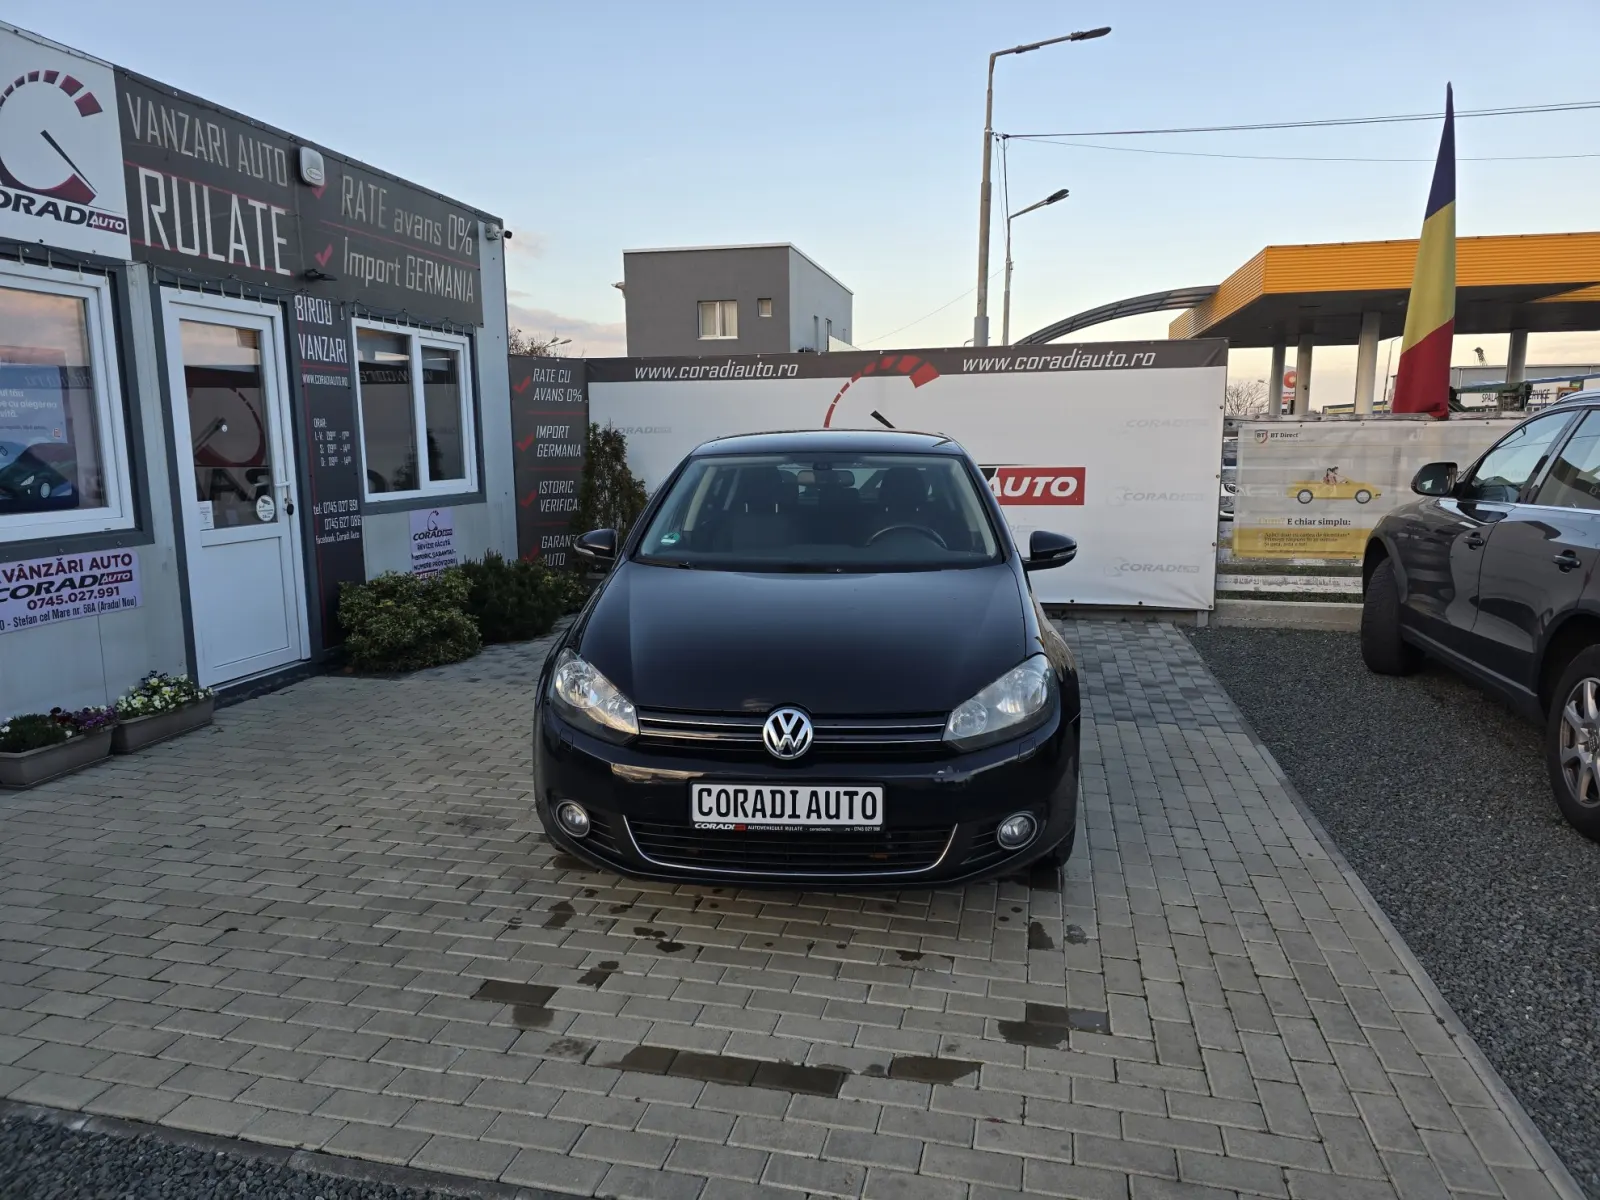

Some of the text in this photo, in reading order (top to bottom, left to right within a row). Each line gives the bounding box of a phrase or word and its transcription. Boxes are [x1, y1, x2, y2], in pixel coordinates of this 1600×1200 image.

[126, 92, 288, 188] VANZARI AUTO
[89, 211, 125, 231] AUTO
[138, 166, 291, 276] RULATE
[341, 175, 473, 256] RATE avans 0%
[343, 236, 474, 304] Import GERMANIA
[294, 295, 332, 325] BIROU
[298, 333, 347, 363] VANZARI
[635, 359, 799, 379] www.coradiauto.ro
[963, 348, 1156, 371] www.coradiauto.ro
[533, 368, 571, 383] RATE CU
[533, 387, 582, 403] AVANS 0%
[536, 425, 570, 439] IMPORT
[537, 443, 581, 458] GERMANIA
[539, 480, 574, 495] ISTORIC
[988, 476, 1078, 497] AUTO
[323, 501, 337, 514] 0745
[540, 498, 581, 513] VERIFICA
[1294, 517, 1316, 526] chiar
[1318, 517, 1351, 527] simplu:
[541, 534, 578, 549] GARAN
[2, 553, 133, 583] VÂNZĂRI AUTO
[101, 572, 131, 584] AUTO
[27, 586, 120, 611] 0745.027.991
[13, 614, 38, 628] Stefan
[39, 612, 50, 622] cel
[52, 608, 71, 620] Mare
[83, 603, 96, 613] 58A
[98, 599, 121, 614] (Aradul
[122, 596, 137, 608] Nou)
[697, 787, 878, 820] CORADI AUTO
[694, 822, 735, 830] CORADI
